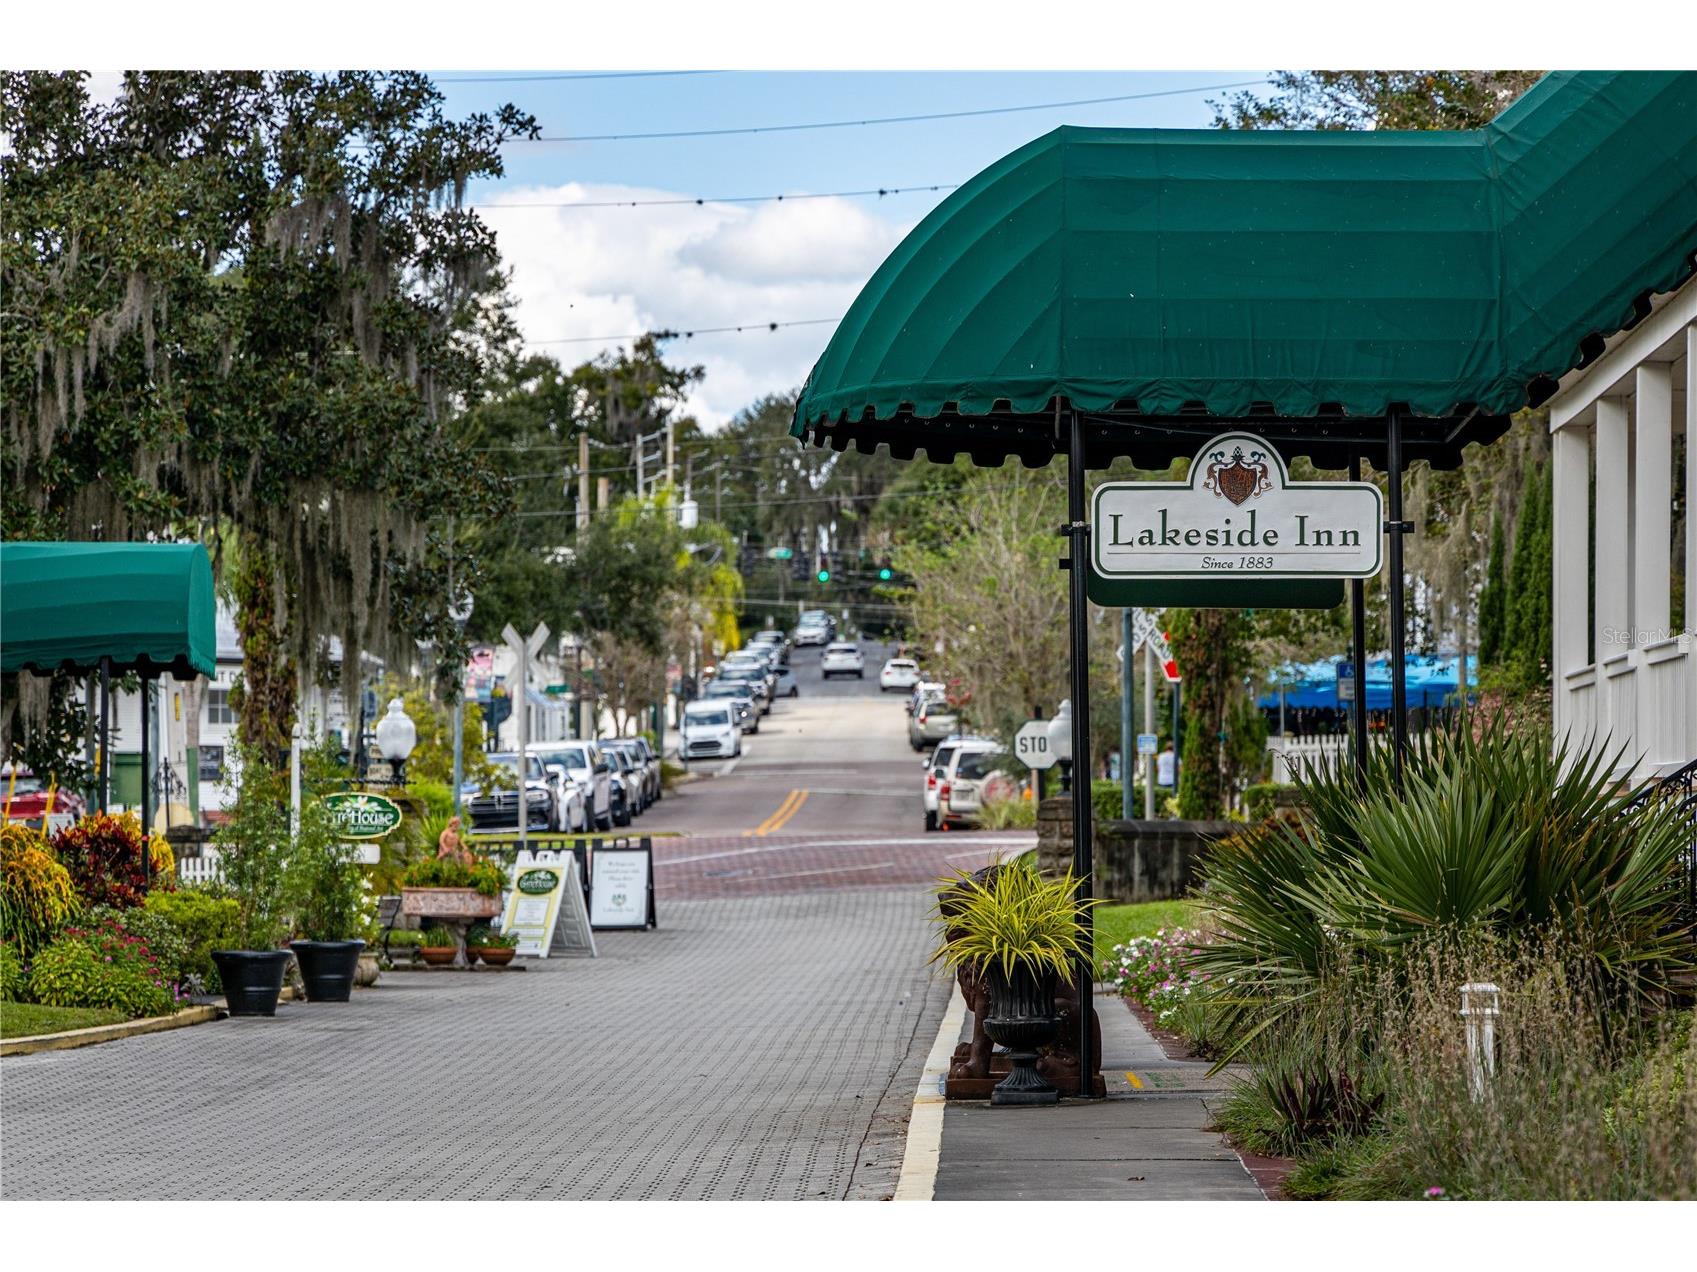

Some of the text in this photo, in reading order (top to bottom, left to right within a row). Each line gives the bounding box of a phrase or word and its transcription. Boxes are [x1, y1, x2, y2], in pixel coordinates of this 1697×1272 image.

[1108, 508, 1361, 547] Lakeside Inn
[1200, 556, 1274, 570] Since 1883
[1019, 735, 1048, 754] STO
